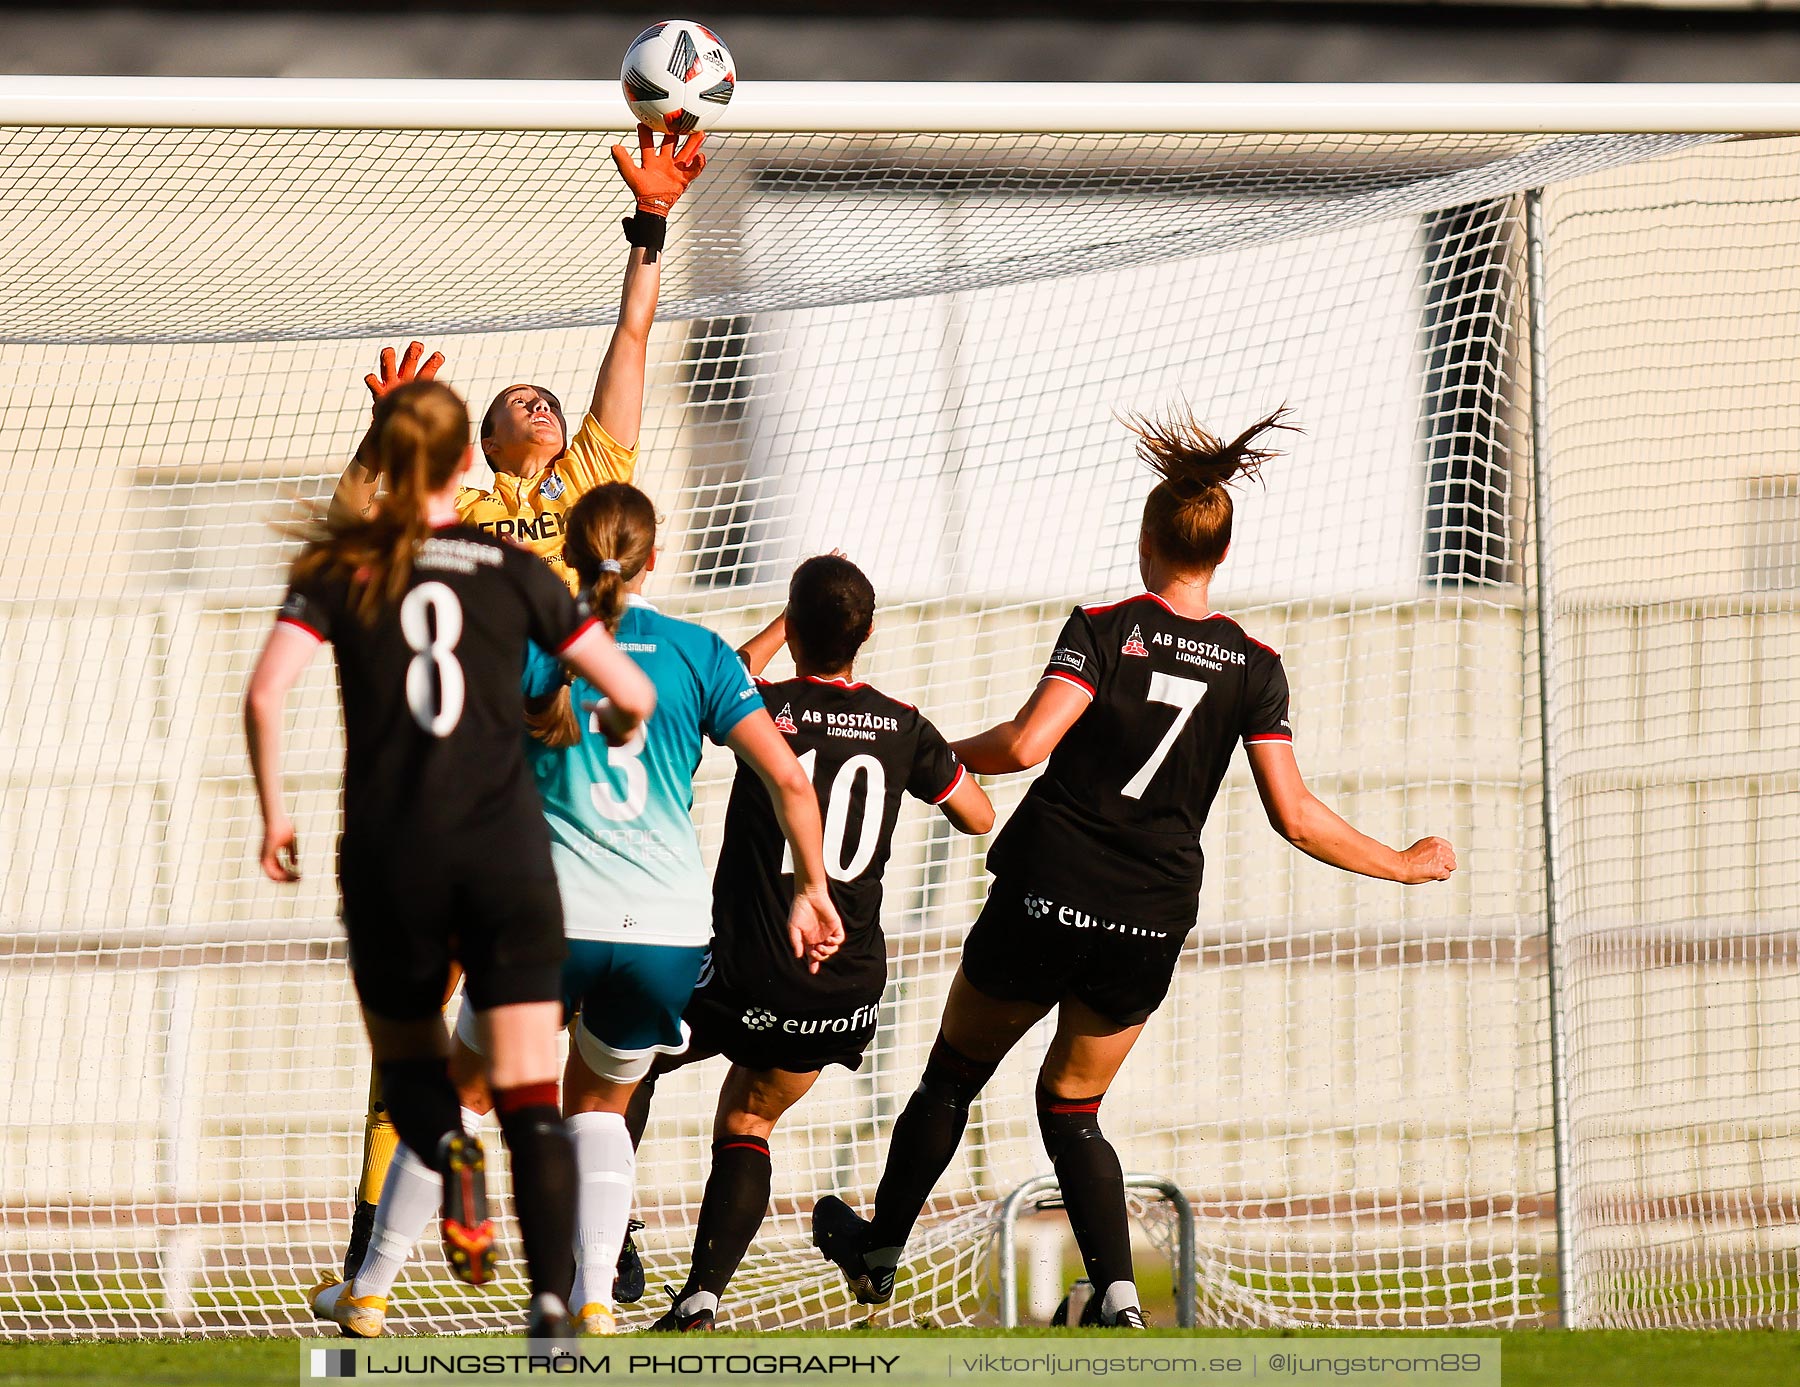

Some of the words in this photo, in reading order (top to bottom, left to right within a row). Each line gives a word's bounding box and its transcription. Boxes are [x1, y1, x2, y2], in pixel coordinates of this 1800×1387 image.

[400, 581, 465, 738] 8
[1152, 632, 1173, 646] AB
[1177, 637, 1246, 666] BOSTÄDER
[1175, 651, 1223, 672] LIDKÖPING
[801, 709, 822, 723] AB
[826, 713, 898, 732] BOSTÄDER
[826, 726, 876, 741] LIDKÖPING
[1120, 671, 1208, 800] 7
[588, 697, 648, 822] 3
